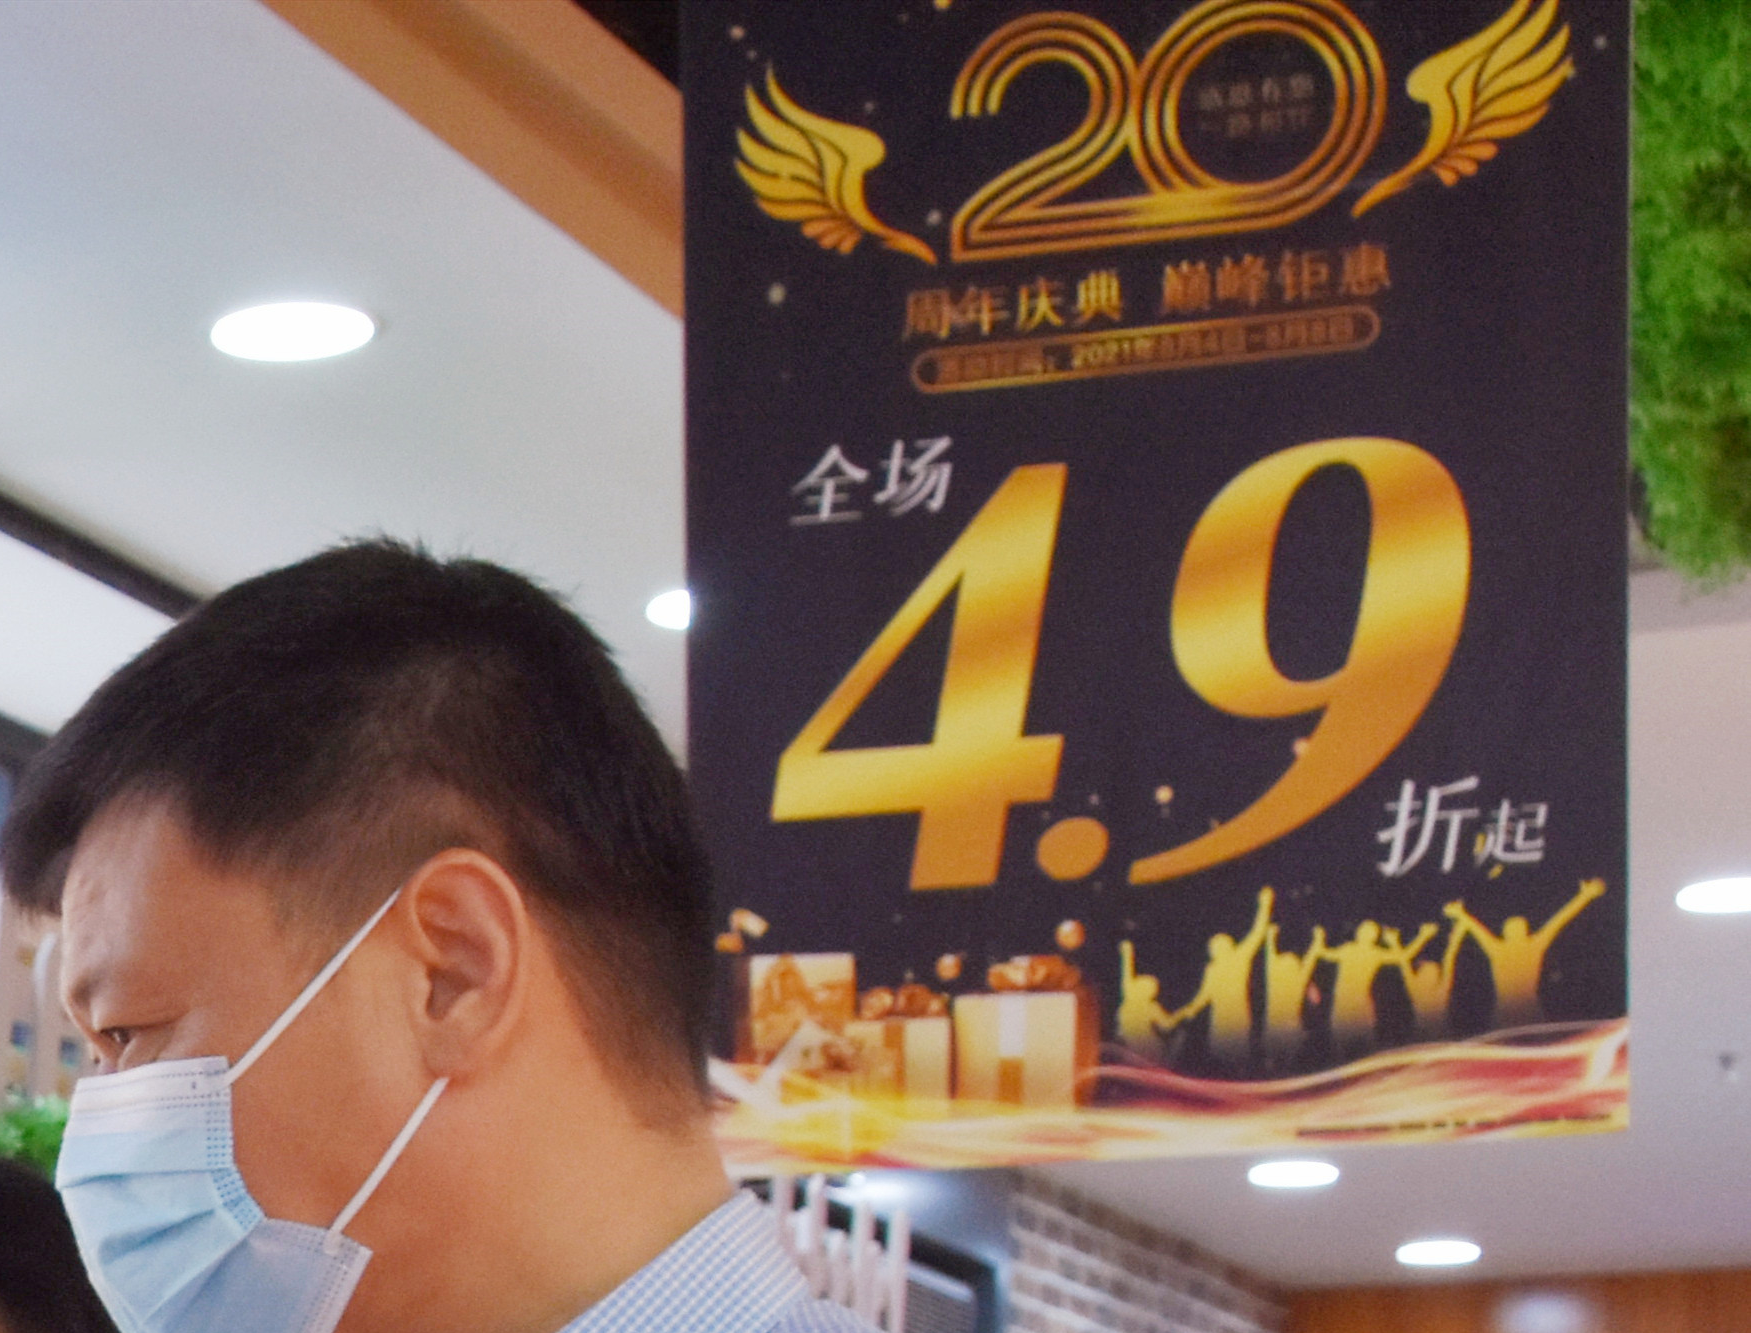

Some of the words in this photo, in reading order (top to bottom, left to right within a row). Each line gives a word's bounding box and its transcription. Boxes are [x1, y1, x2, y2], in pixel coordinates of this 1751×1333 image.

[950, 0, 1387, 262] 20
[905, 269, 1124, 340] 周年庆典
[791, 437, 953, 525] 全场
[771, 437, 1471, 890] 4.9
[1378, 777, 1548, 878] 折起
